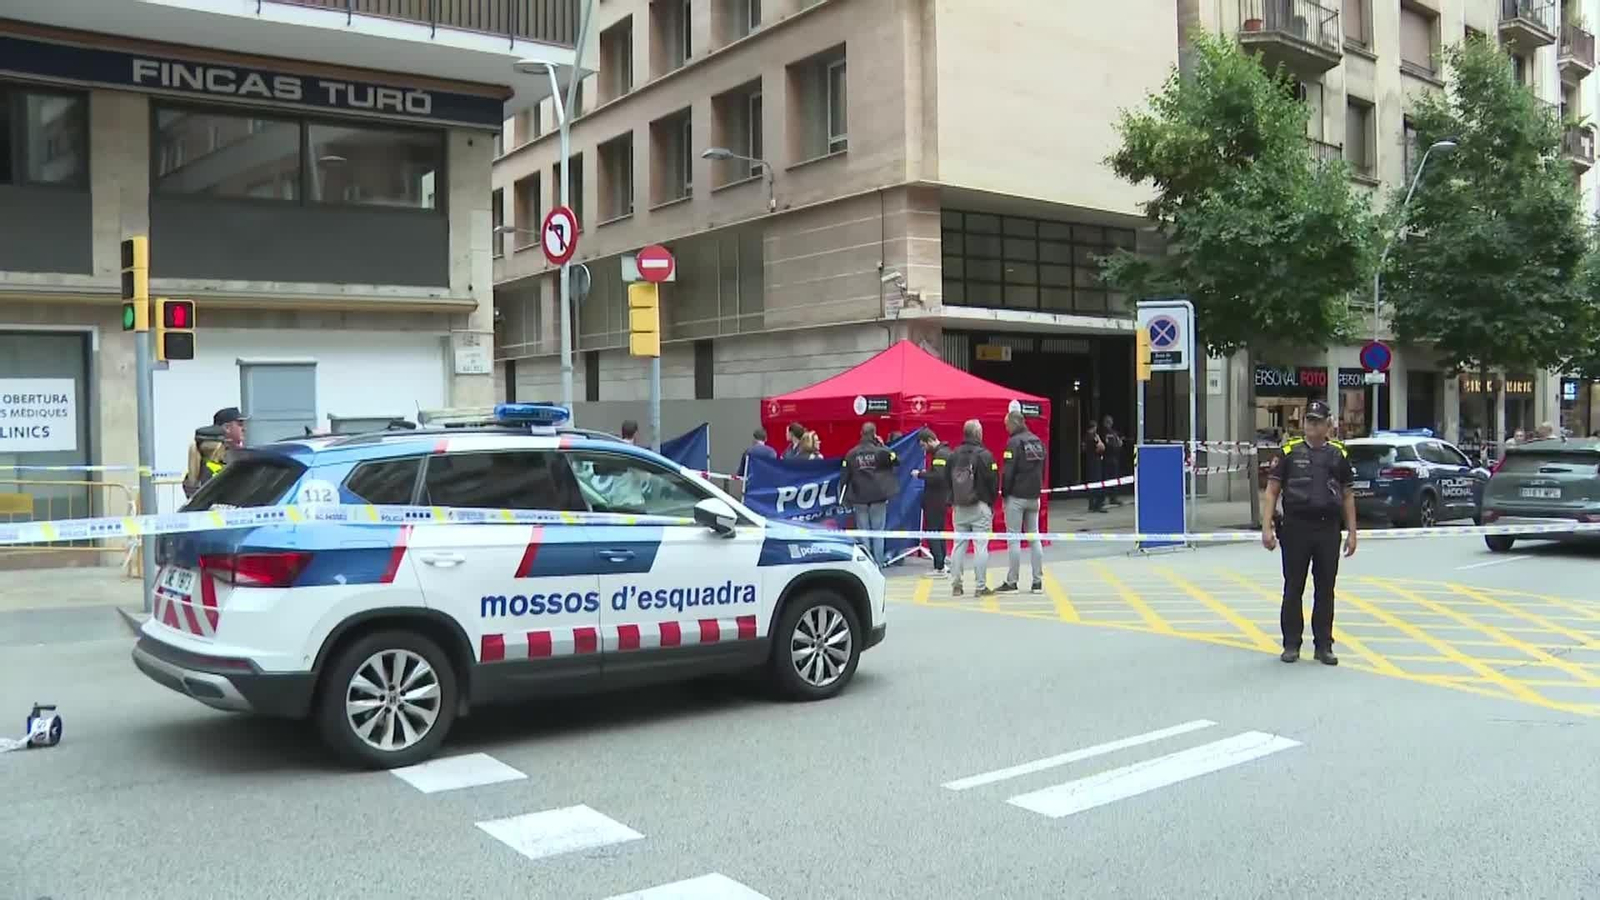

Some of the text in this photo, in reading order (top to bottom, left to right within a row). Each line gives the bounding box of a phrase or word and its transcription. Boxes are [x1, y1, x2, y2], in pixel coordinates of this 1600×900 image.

[132, 59, 432, 114] FINCAS TURÓ
[1300, 372, 1327, 387] FOTO
[304, 489, 332, 503] 112
[480, 580, 756, 618] mossos d'esquadra
